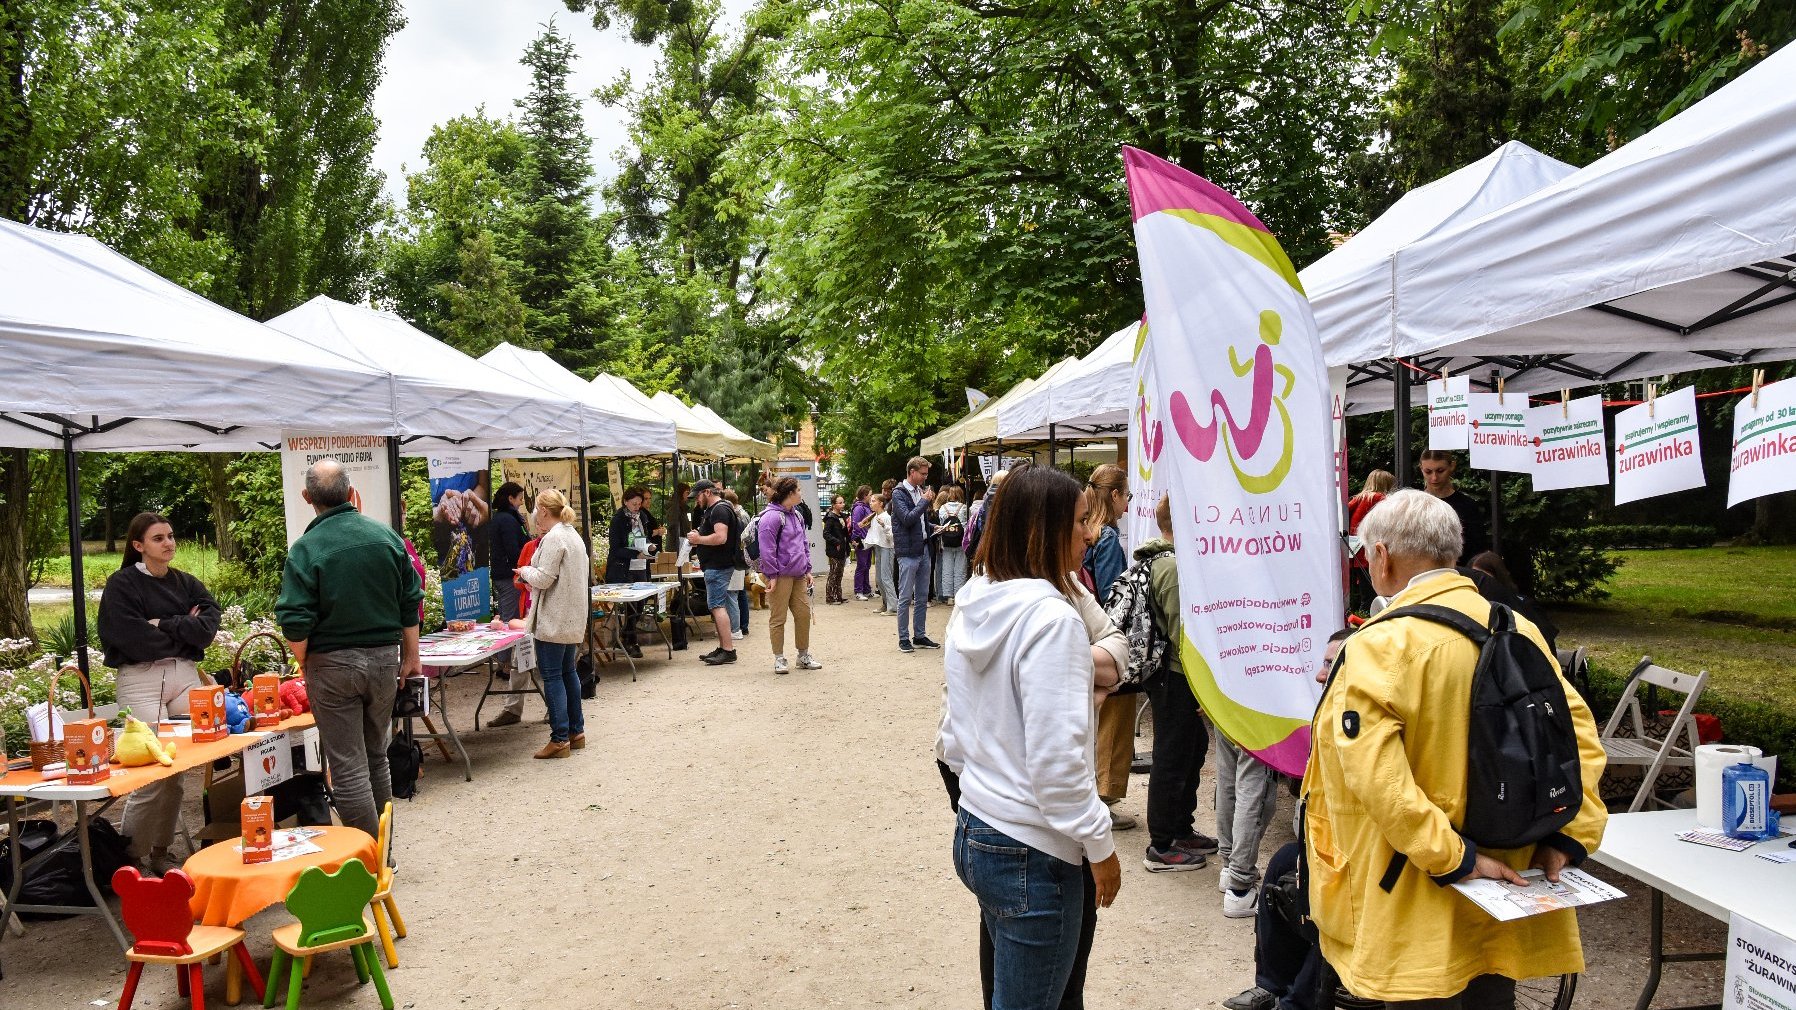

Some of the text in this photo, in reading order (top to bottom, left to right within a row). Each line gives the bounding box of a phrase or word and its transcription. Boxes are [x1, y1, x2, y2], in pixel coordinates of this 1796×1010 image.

[1765, 410, 1775, 423] od
[1777, 407, 1788, 419] 30
[287, 435, 388, 452] WESPRZYJ PODOPIECZNYCH
[334, 452, 355, 464] STUDIO
[355, 451, 373, 463] FIGURA
[457, 593, 481, 611] URATUJ
[247, 733, 286, 752] FUNDACJA STUDIO
[260, 745, 277, 756] FIGURA
[1736, 937, 1796, 976] STOWARZYS
